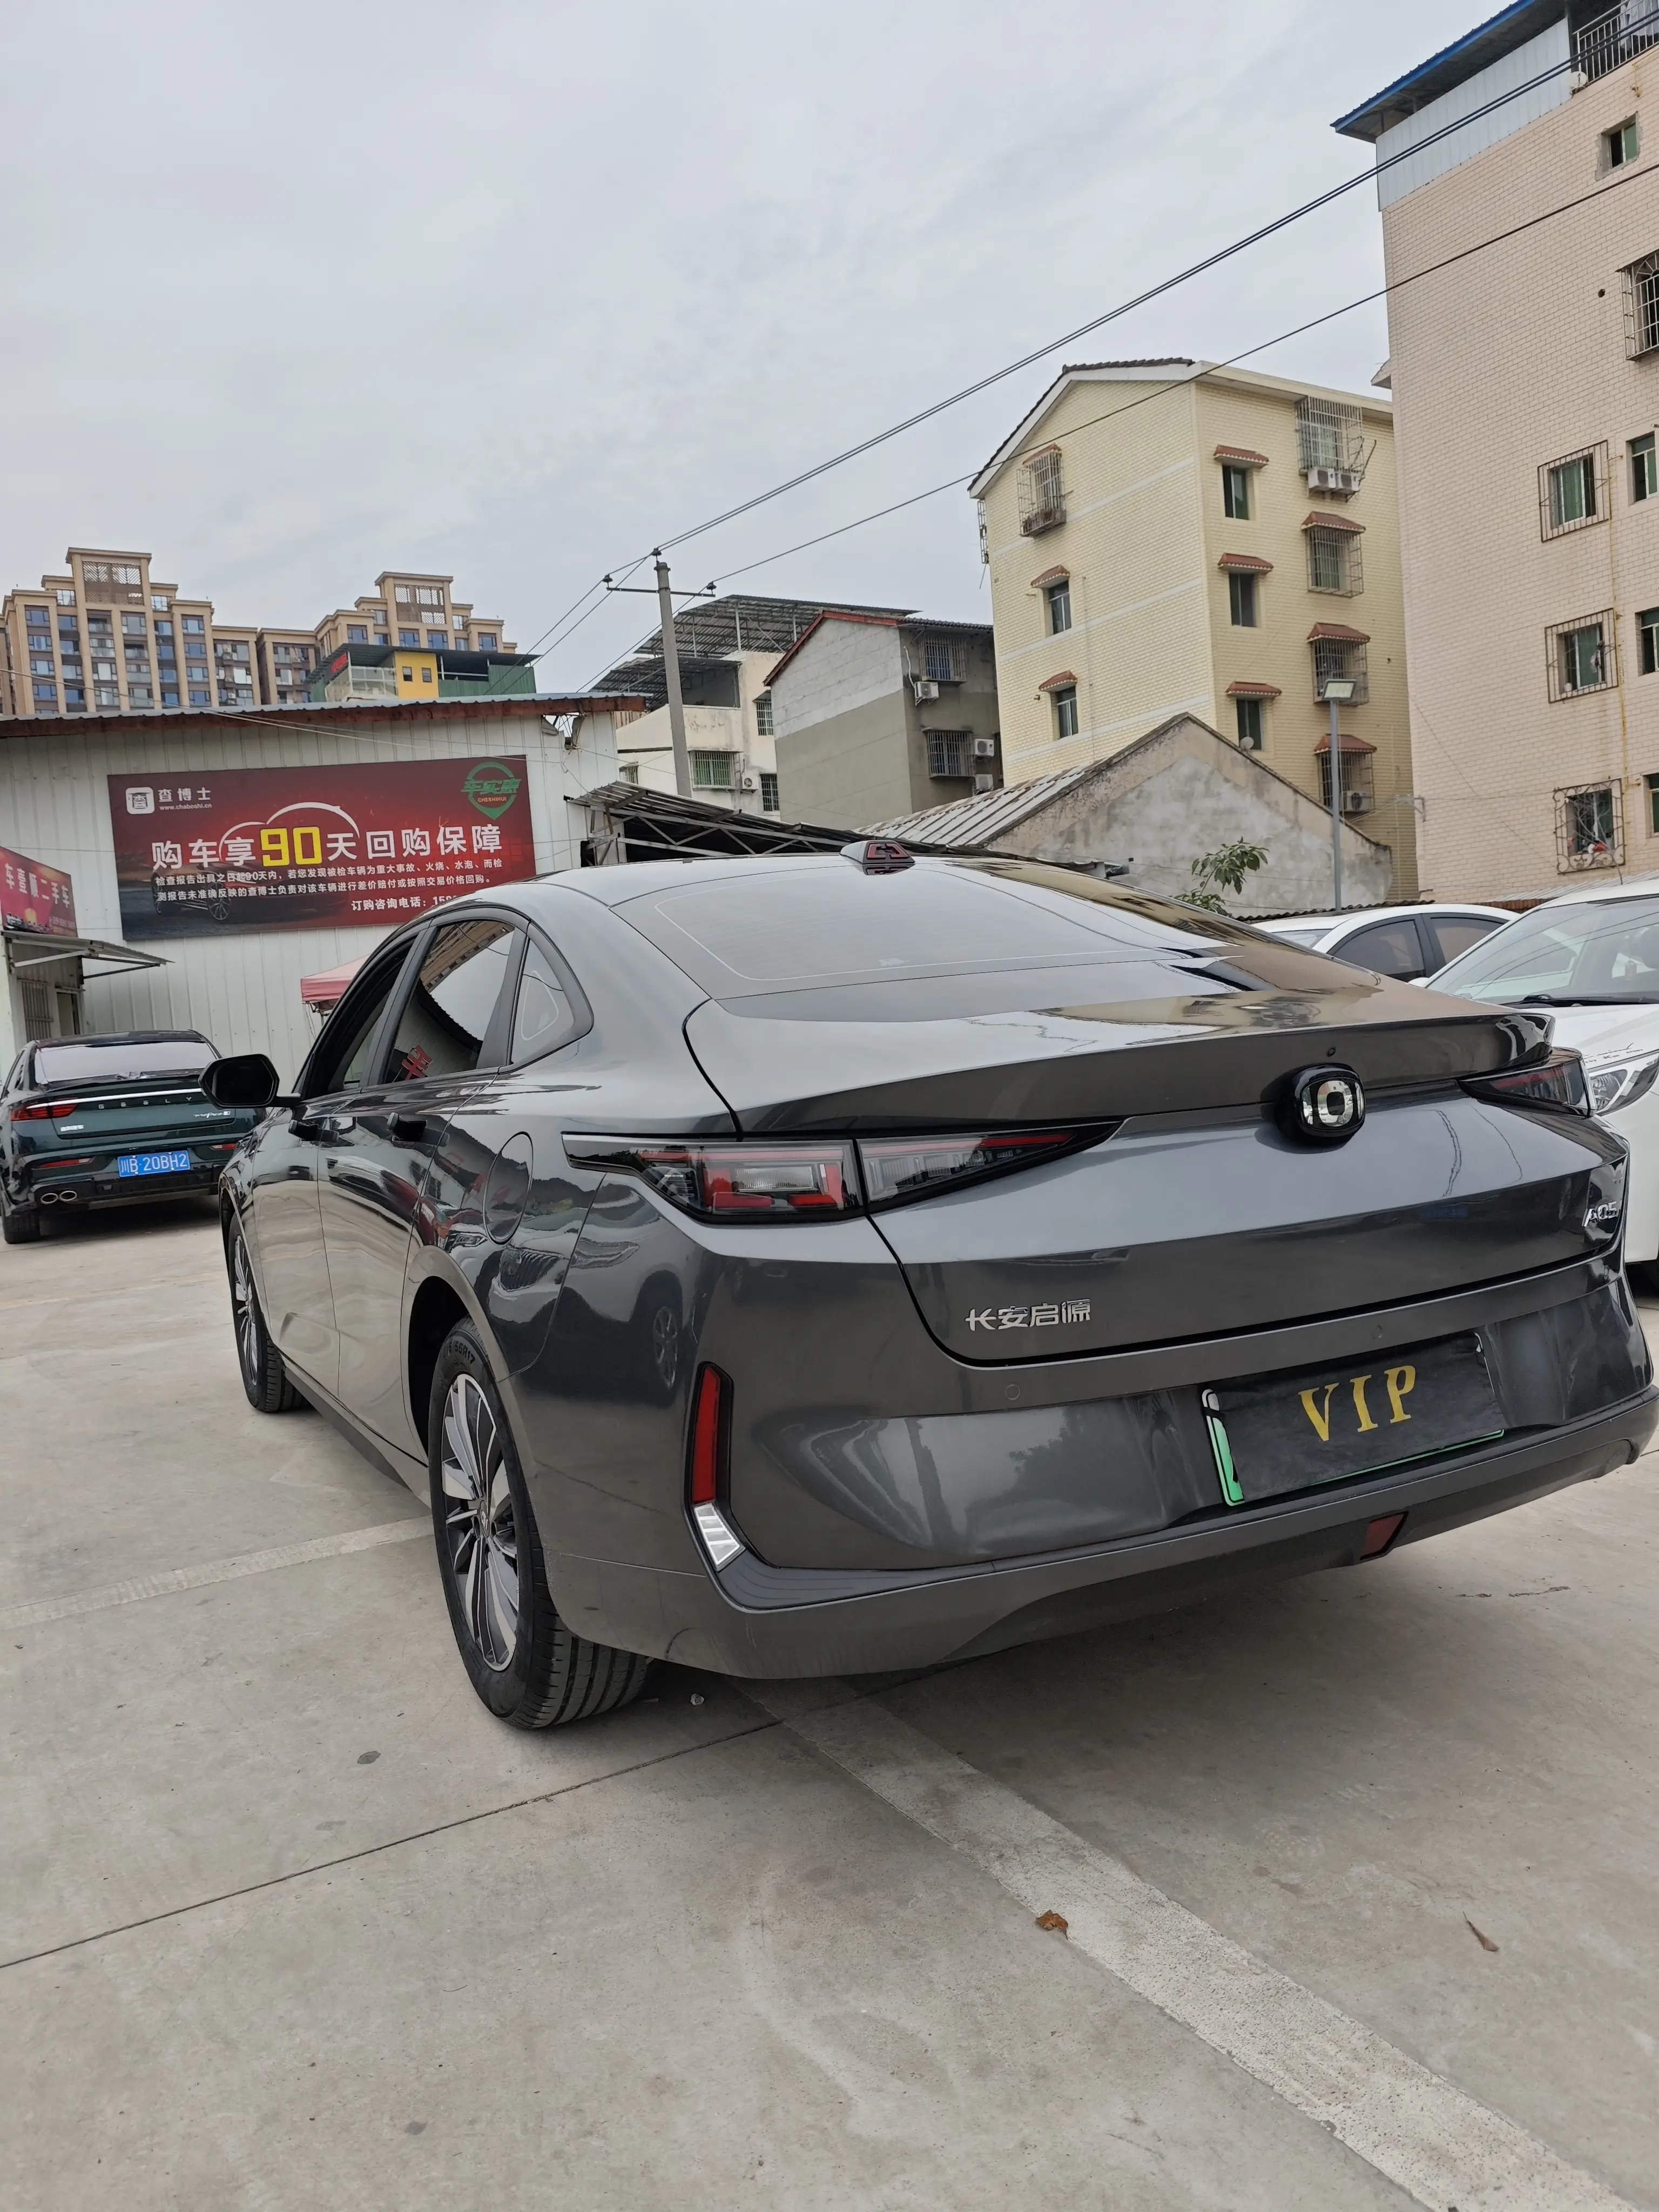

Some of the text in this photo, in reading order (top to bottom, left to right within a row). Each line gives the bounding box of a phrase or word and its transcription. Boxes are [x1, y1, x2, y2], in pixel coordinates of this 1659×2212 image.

[158, 787, 211, 802] 查博士
[159, 802, 212, 811] www.chaboshi.cn
[151, 824, 503, 870] 购车享90天回购保障
[98, 1096, 192, 1109] GEELY
[965, 1298, 1091, 1331] 长安启源
[1298, 1365, 1417, 1441] VIP
